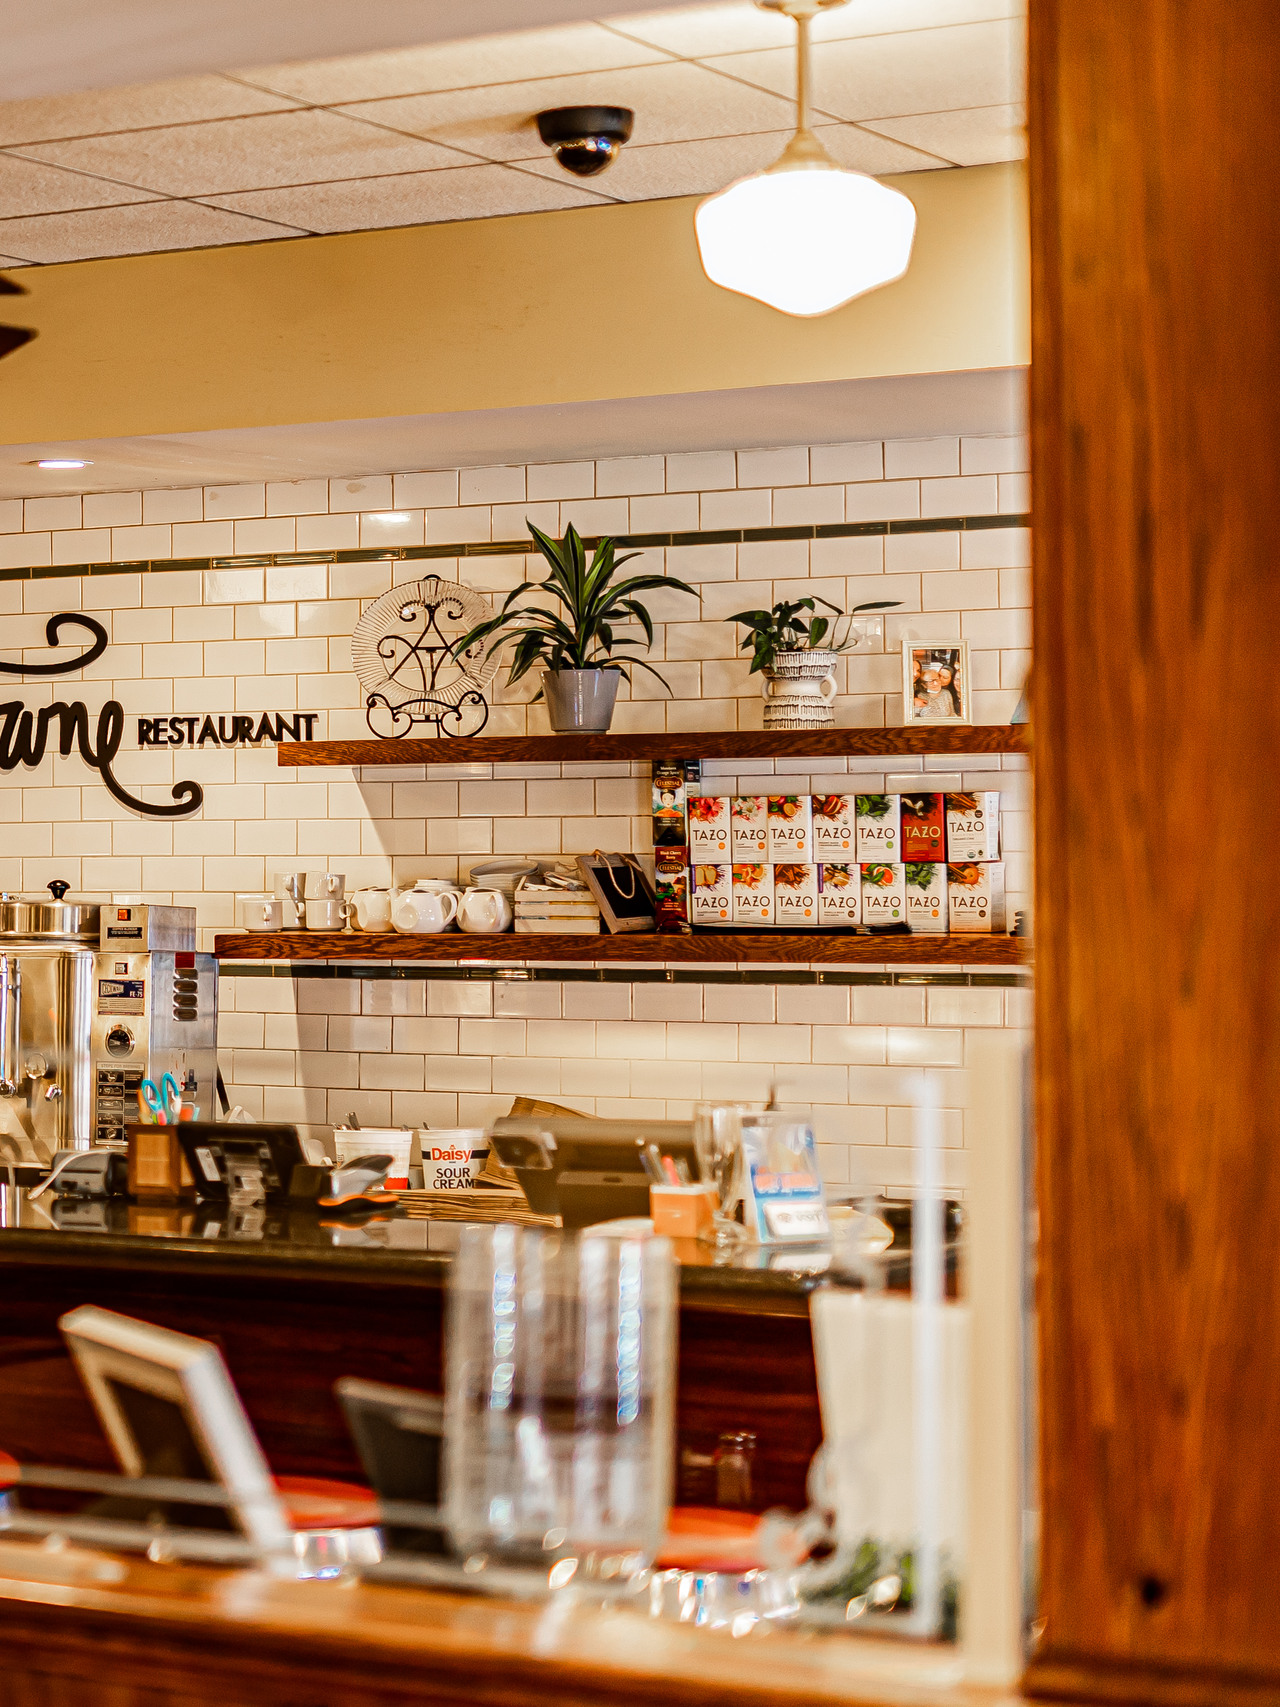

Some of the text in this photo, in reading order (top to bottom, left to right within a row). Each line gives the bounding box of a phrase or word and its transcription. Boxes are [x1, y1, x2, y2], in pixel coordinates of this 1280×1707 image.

[137, 713, 319, 746] RESTAURANT
[815, 827, 851, 839] TAZO
[859, 827, 896, 839] TAZO
[904, 826, 941, 838] TAZO
[949, 821, 985, 833] TAZO
[692, 829, 728, 841] TAZO
[733, 829, 767, 841] TAZO
[771, 828, 806, 840] TAZO
[694, 897, 729, 908] TAZO
[735, 896, 770, 907] TAZO
[778, 896, 813, 907] TAZO
[821, 897, 857, 908] TAZO
[865, 896, 901, 908] TAZO
[908, 896, 940, 908] TAZO
[951, 896, 988, 908] TAZO
[431, 1147, 471, 1164] Daisy
[436, 1167, 470, 1179] SOUR
[433, 1178, 475, 1189] CREAM
